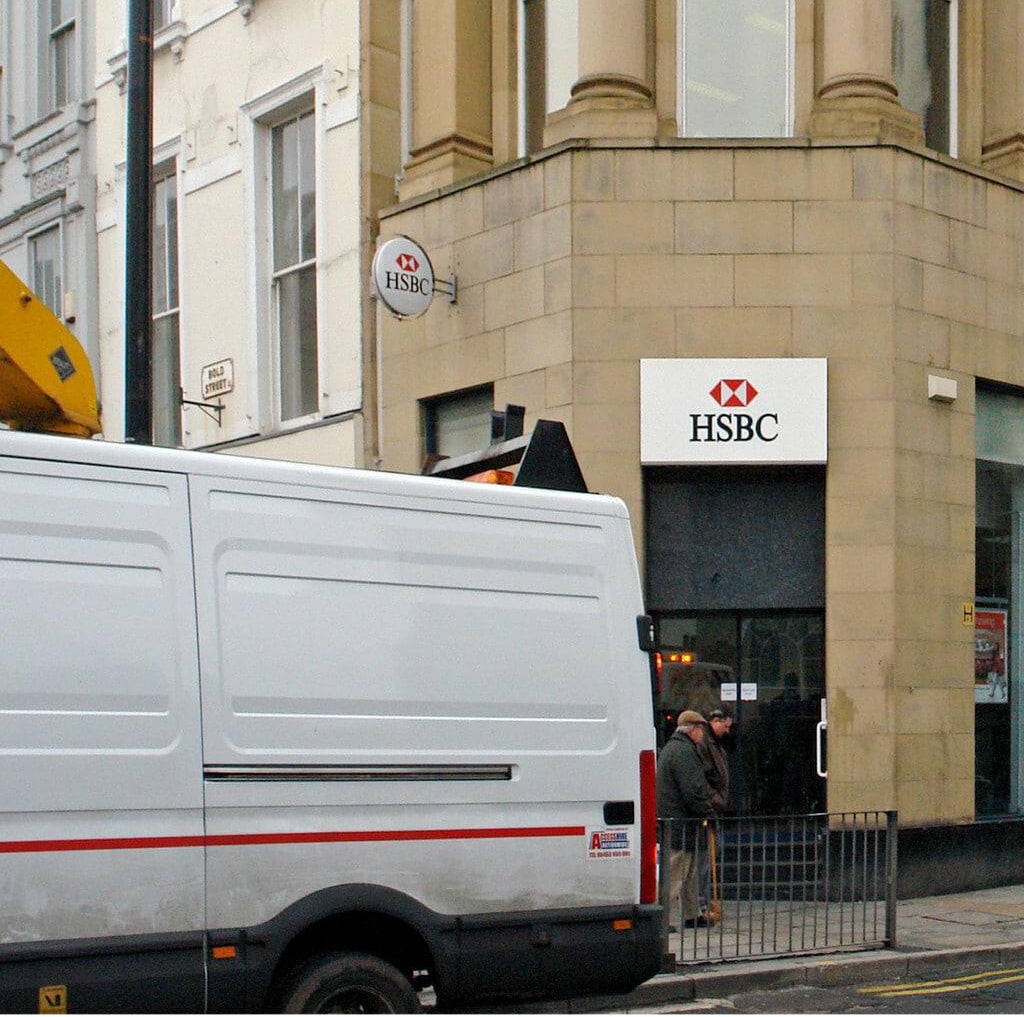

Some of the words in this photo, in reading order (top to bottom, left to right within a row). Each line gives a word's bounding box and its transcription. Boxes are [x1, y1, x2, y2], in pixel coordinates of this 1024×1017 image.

[385, 270, 430, 296] HSBC
[208, 366, 225, 379] BOLD
[205, 378, 227, 394] STREET
[689, 413, 779, 442] HSBC
[964, 605, 973, 622] H
